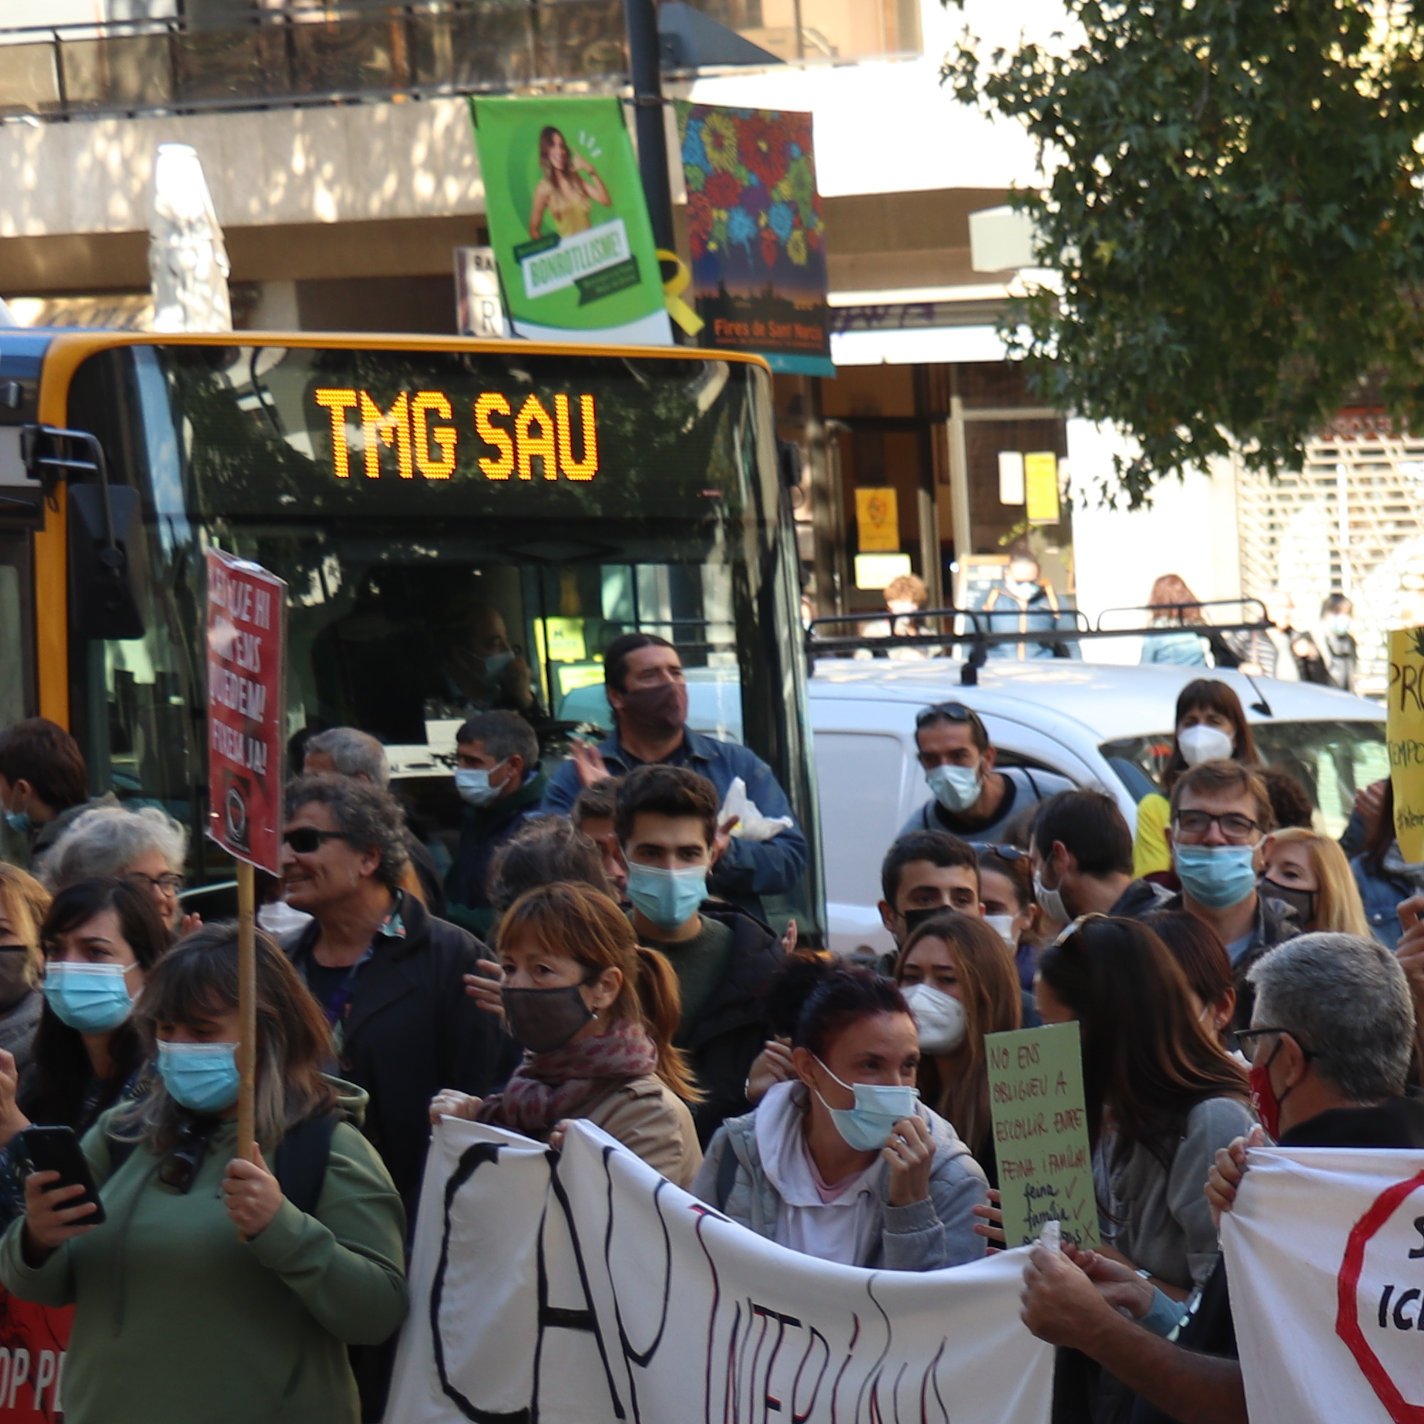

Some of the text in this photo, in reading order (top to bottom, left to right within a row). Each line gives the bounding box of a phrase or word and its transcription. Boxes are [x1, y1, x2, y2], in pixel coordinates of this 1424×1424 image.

[315, 388, 598, 480] TMG SAU
[254, 588, 271, 630] HI
[990, 1042, 1041, 1072] NO ENS
[1055, 1069, 1068, 1096] A
[1001, 1157, 1037, 1181] FEINA
